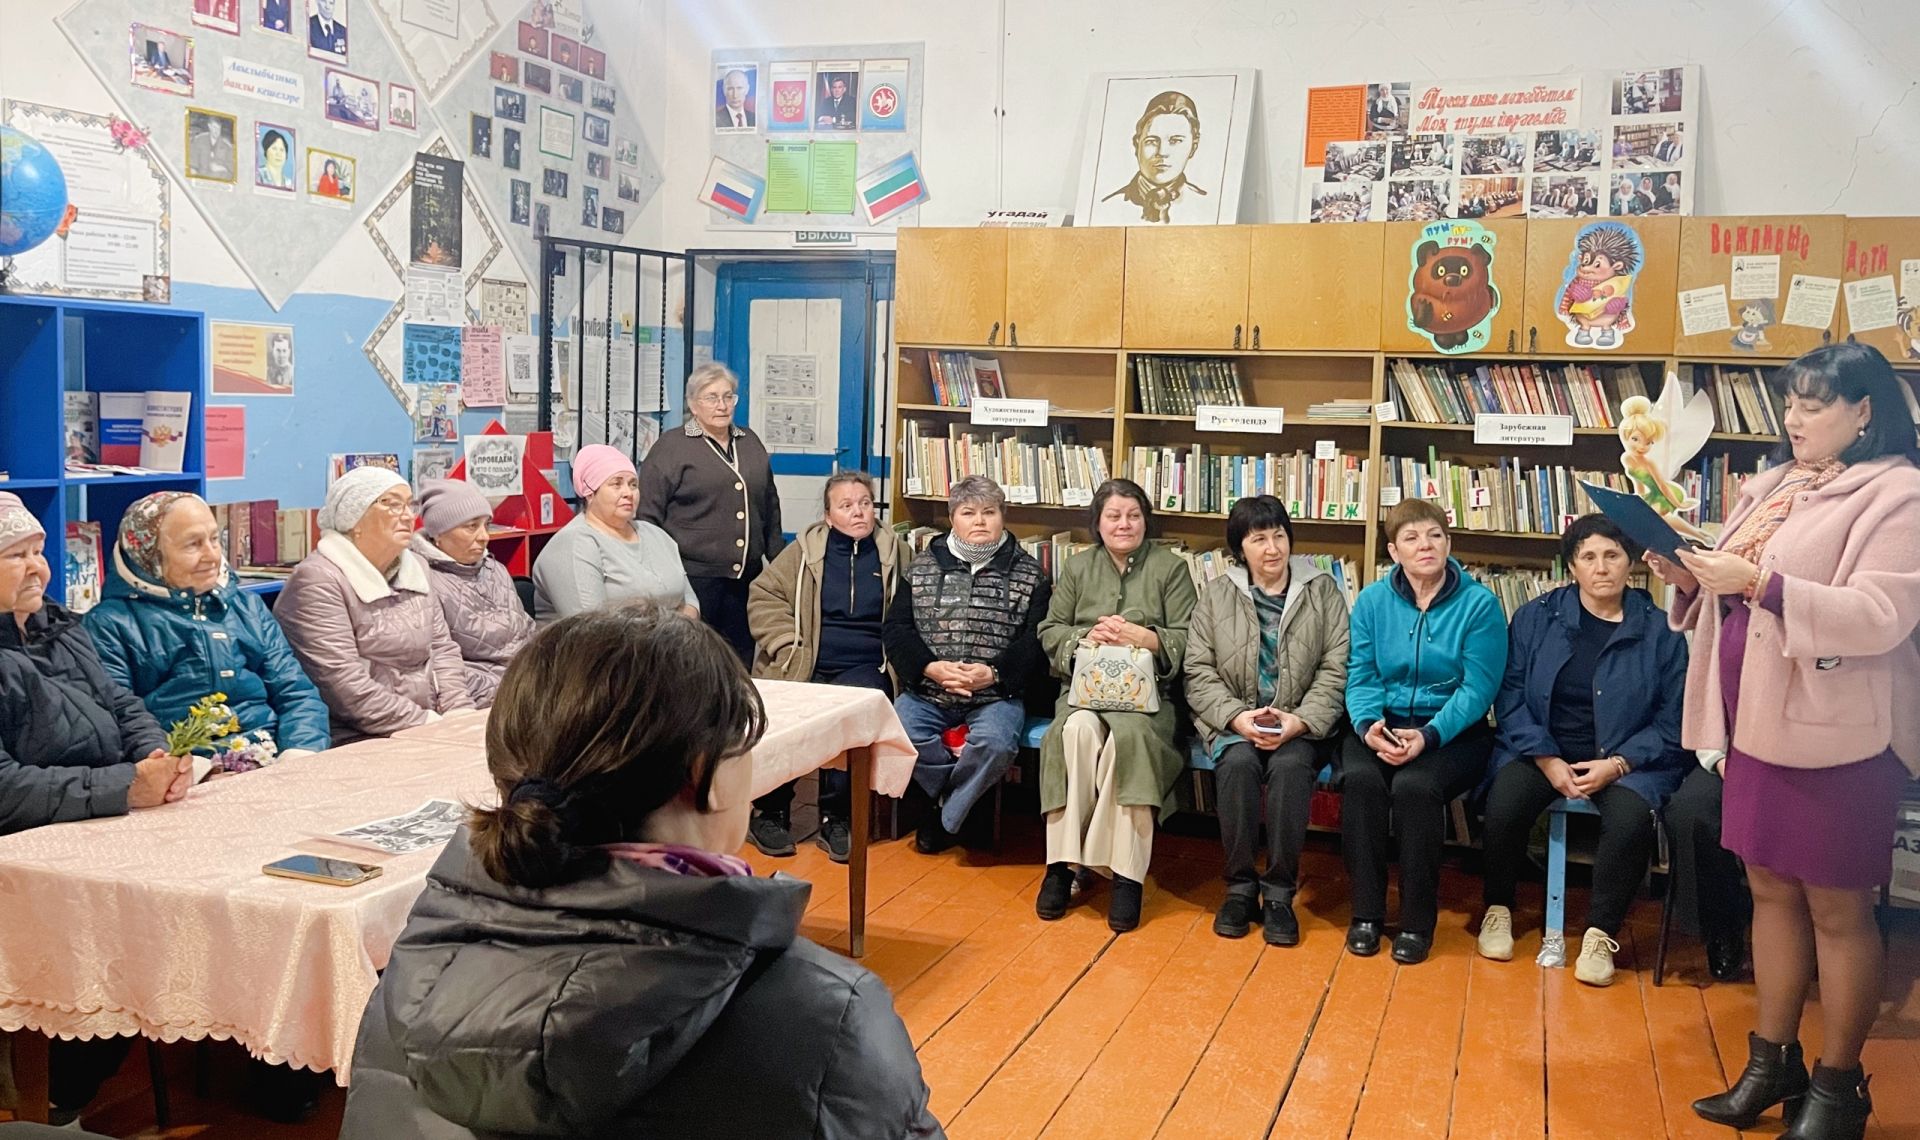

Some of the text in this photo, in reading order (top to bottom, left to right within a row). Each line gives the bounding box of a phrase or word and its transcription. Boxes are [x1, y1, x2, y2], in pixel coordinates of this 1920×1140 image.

[223, 78, 300, 104] данлы кешеләре
[1211, 415, 1228, 425] Рус
[1500, 423, 1547, 431] Зарубежная
[1501, 435, 1545, 443] литература
[478, 453, 512, 464] ПРОВЕДЁМ
[1426, 481, 1438, 496] А
[1166, 496, 1176, 508] Б
[1476, 489, 1484, 505] Г
[1289, 502, 1300, 517] Д
[1326, 504, 1338, 517] Е
[1344, 503, 1359, 518] Ж
